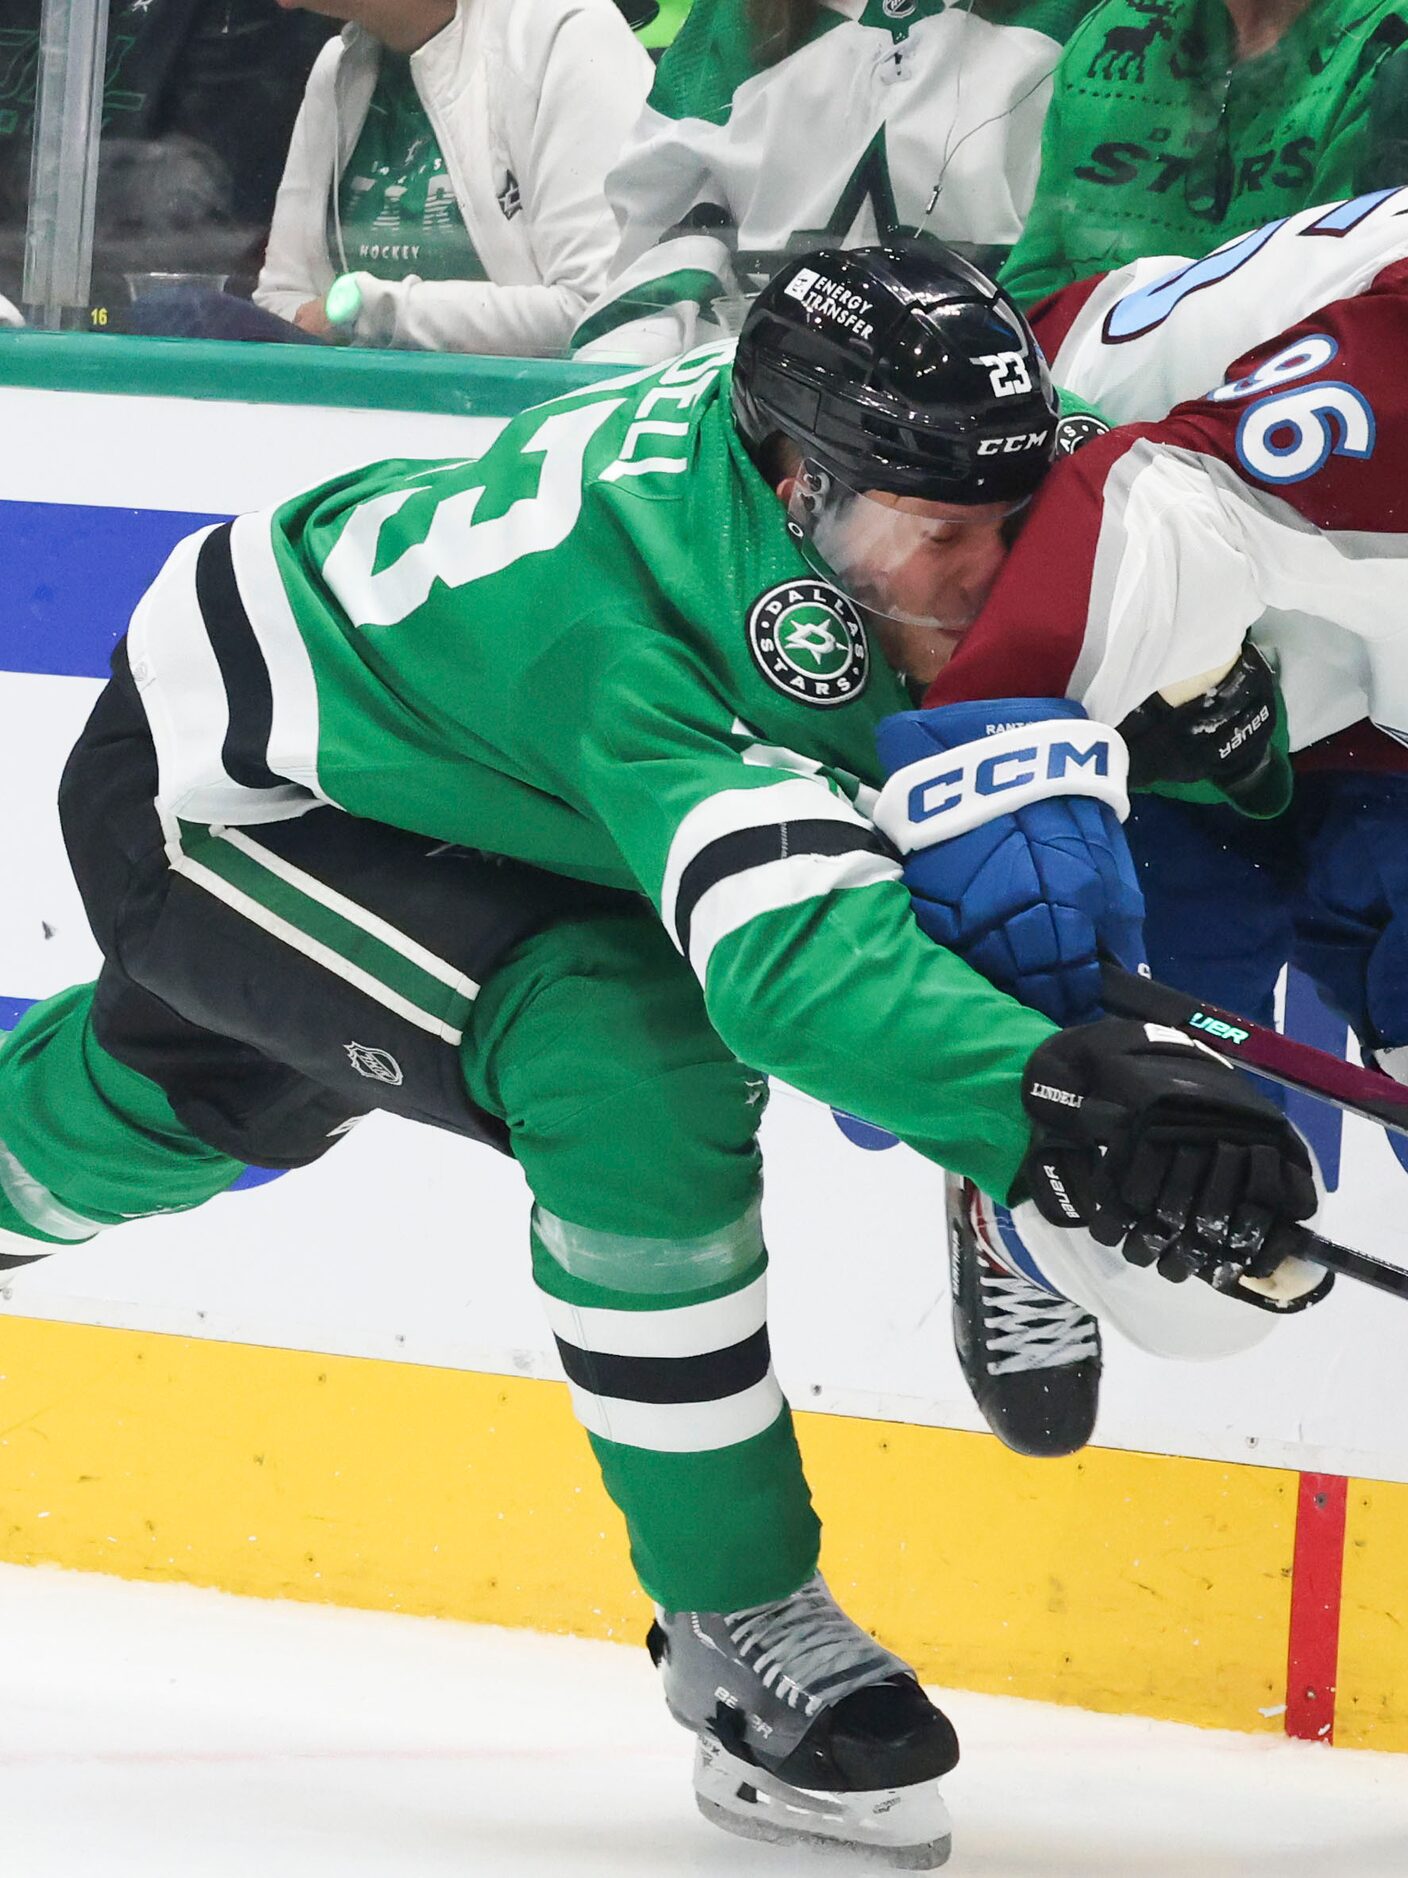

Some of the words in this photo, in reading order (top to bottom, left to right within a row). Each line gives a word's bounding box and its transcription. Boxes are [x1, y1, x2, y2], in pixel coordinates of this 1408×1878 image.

[1074, 136, 1317, 195] STRS
[359, 244, 420, 260] HOCKEY
[91, 307, 109, 326] 16
[805, 291, 875, 340] TRANSFER
[814, 276, 874, 315] ENERGY
[978, 351, 1033, 398] 23
[1206, 332, 1377, 485] 96
[977, 430, 1049, 456] CCM
[764, 588, 866, 660] DALLAS
[760, 637, 852, 695] STARS
[908, 741, 1110, 825] CCM
